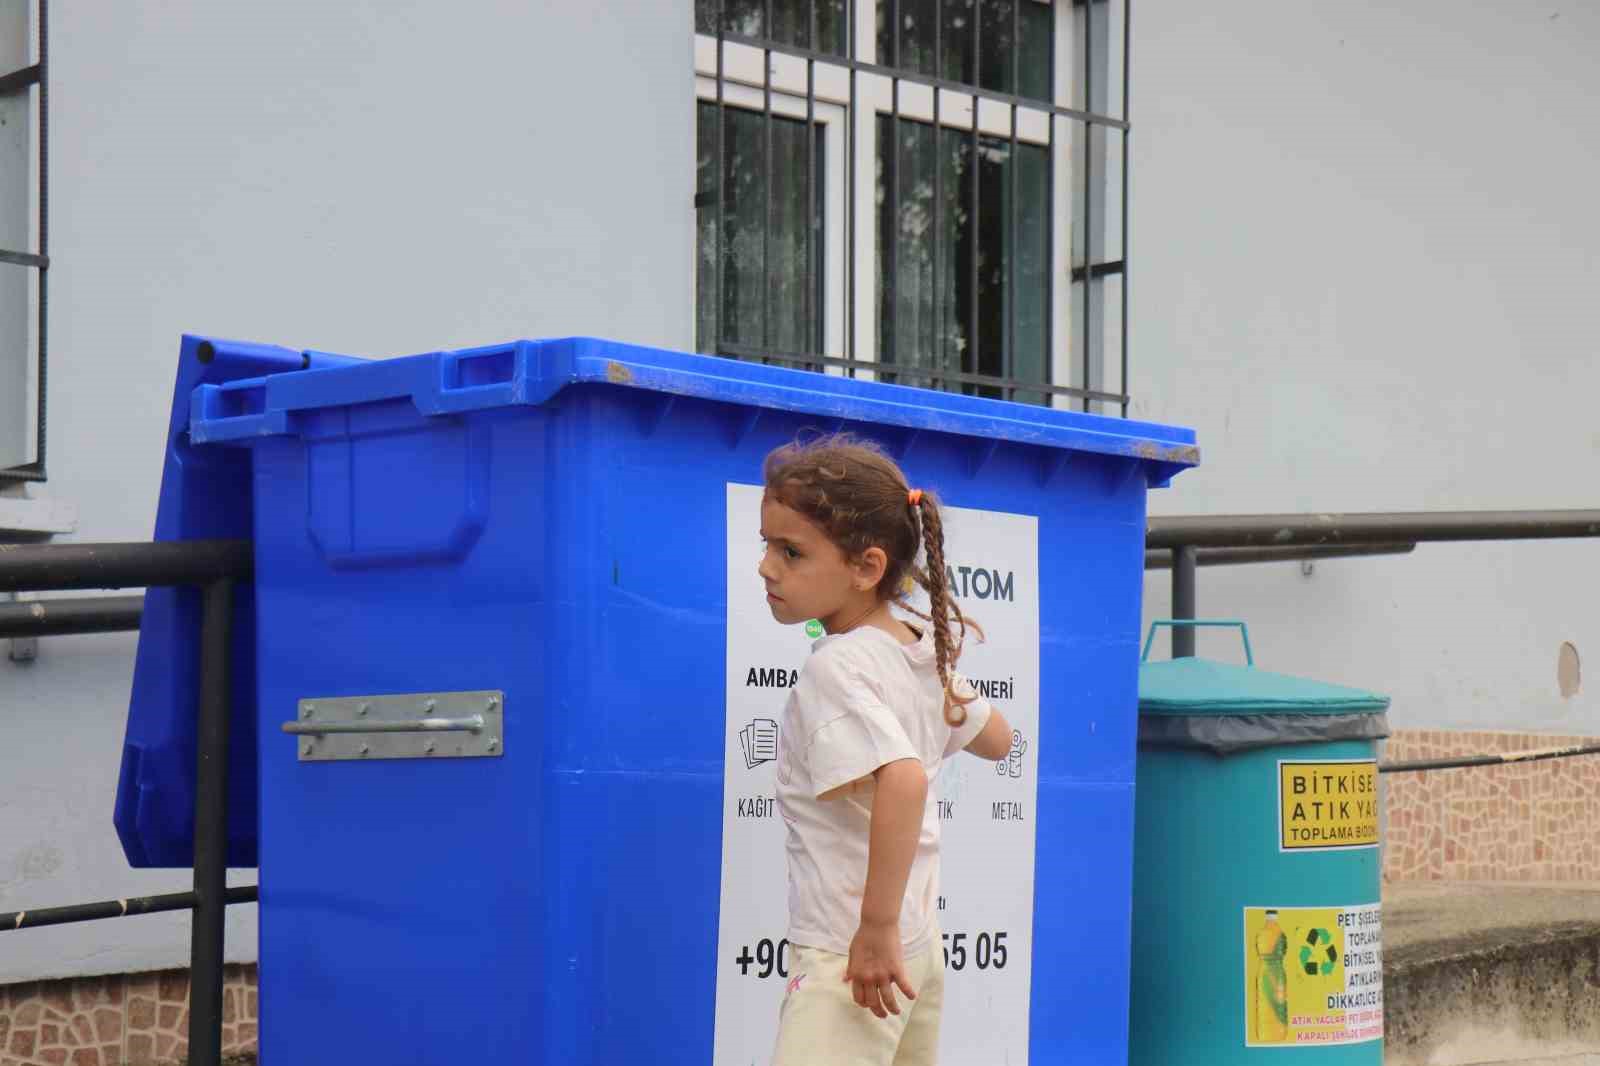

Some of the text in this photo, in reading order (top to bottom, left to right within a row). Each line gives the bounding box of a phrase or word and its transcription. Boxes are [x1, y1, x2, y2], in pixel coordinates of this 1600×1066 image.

[738, 795, 775, 818] KAĞIT
[992, 802, 1024, 820] METAL
[1292, 802, 1350, 821] ATIK
[1290, 826, 1353, 841] TOPLAMA
[1337, 912, 1356, 927] PET
[976, 932, 1008, 970] 05
